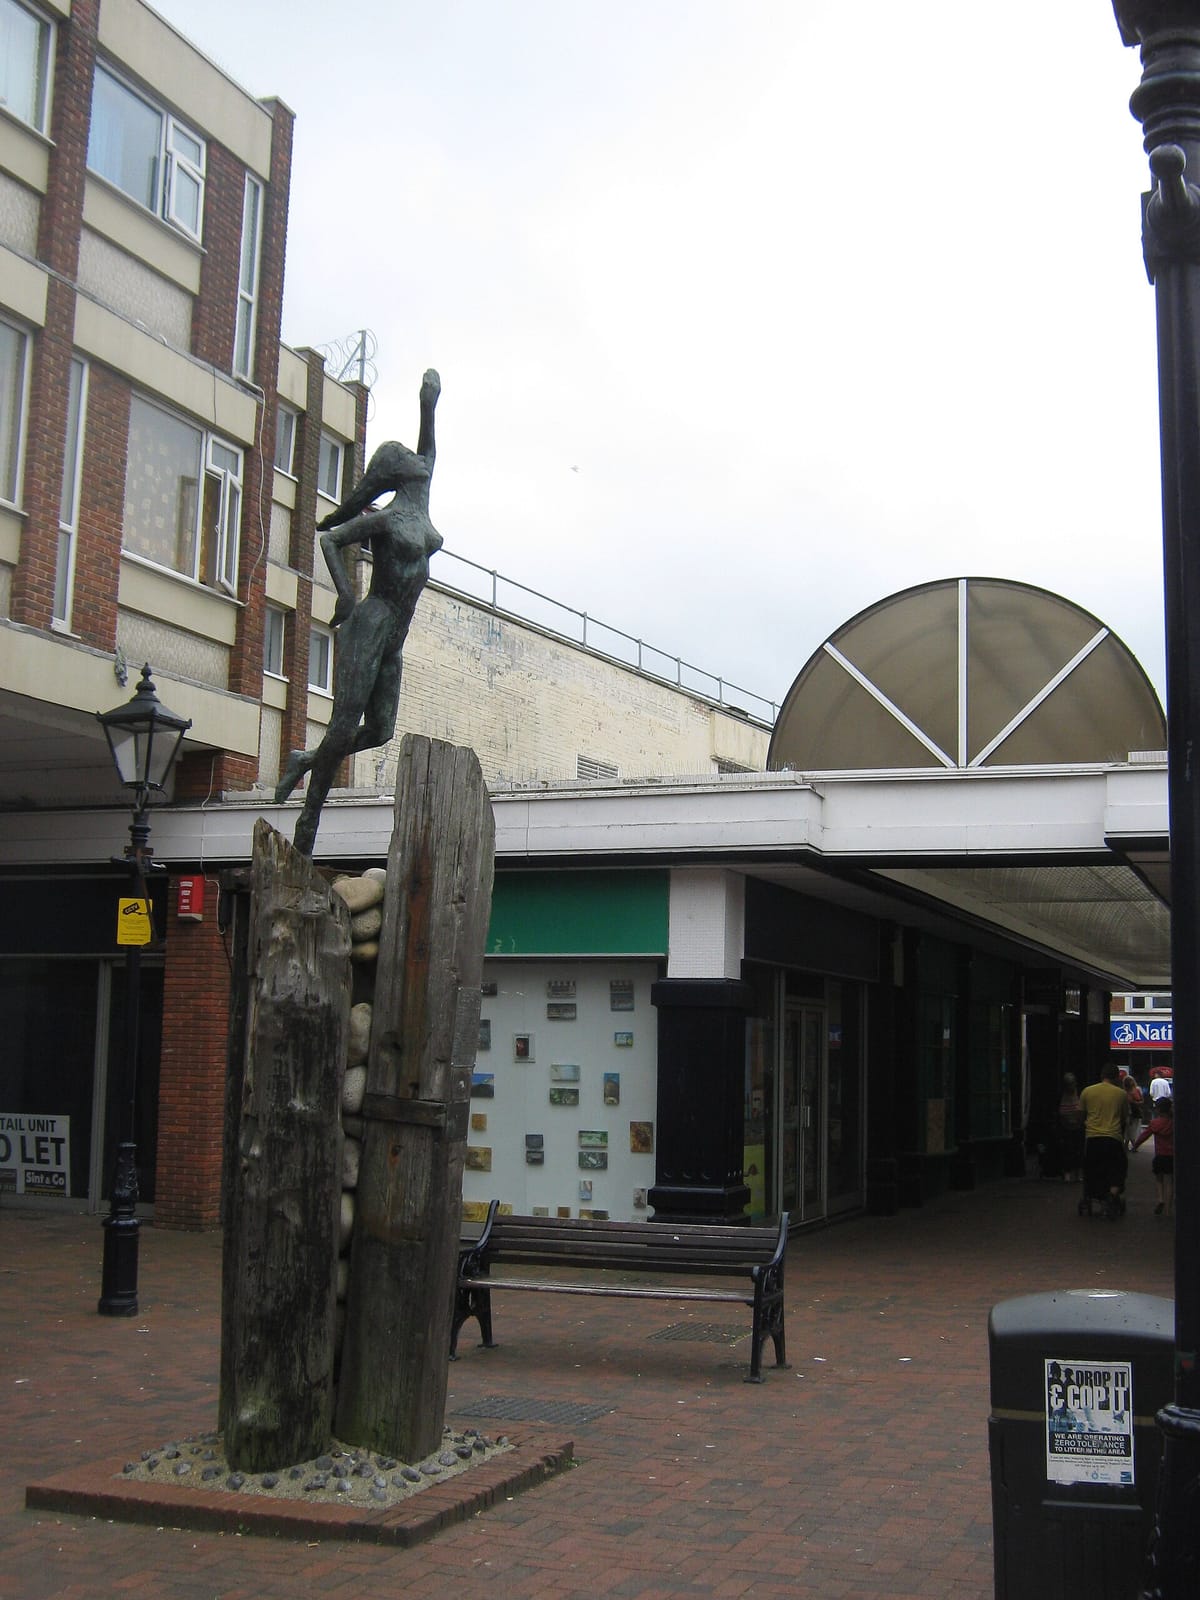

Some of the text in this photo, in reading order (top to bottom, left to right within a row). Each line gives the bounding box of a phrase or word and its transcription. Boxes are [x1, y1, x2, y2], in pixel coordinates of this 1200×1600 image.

[28, 1119, 57, 1132] UNIT
[20, 1135, 65, 1165] LET
[52, 1173, 65, 1186] Co
[1075, 1370, 1127, 1387] DROP IT
[1050, 1384, 1128, 1410] & COP IT
[1077, 1440, 1125, 1449] TOLEANCE
[1083, 1434, 1125, 1442] OPERATING
